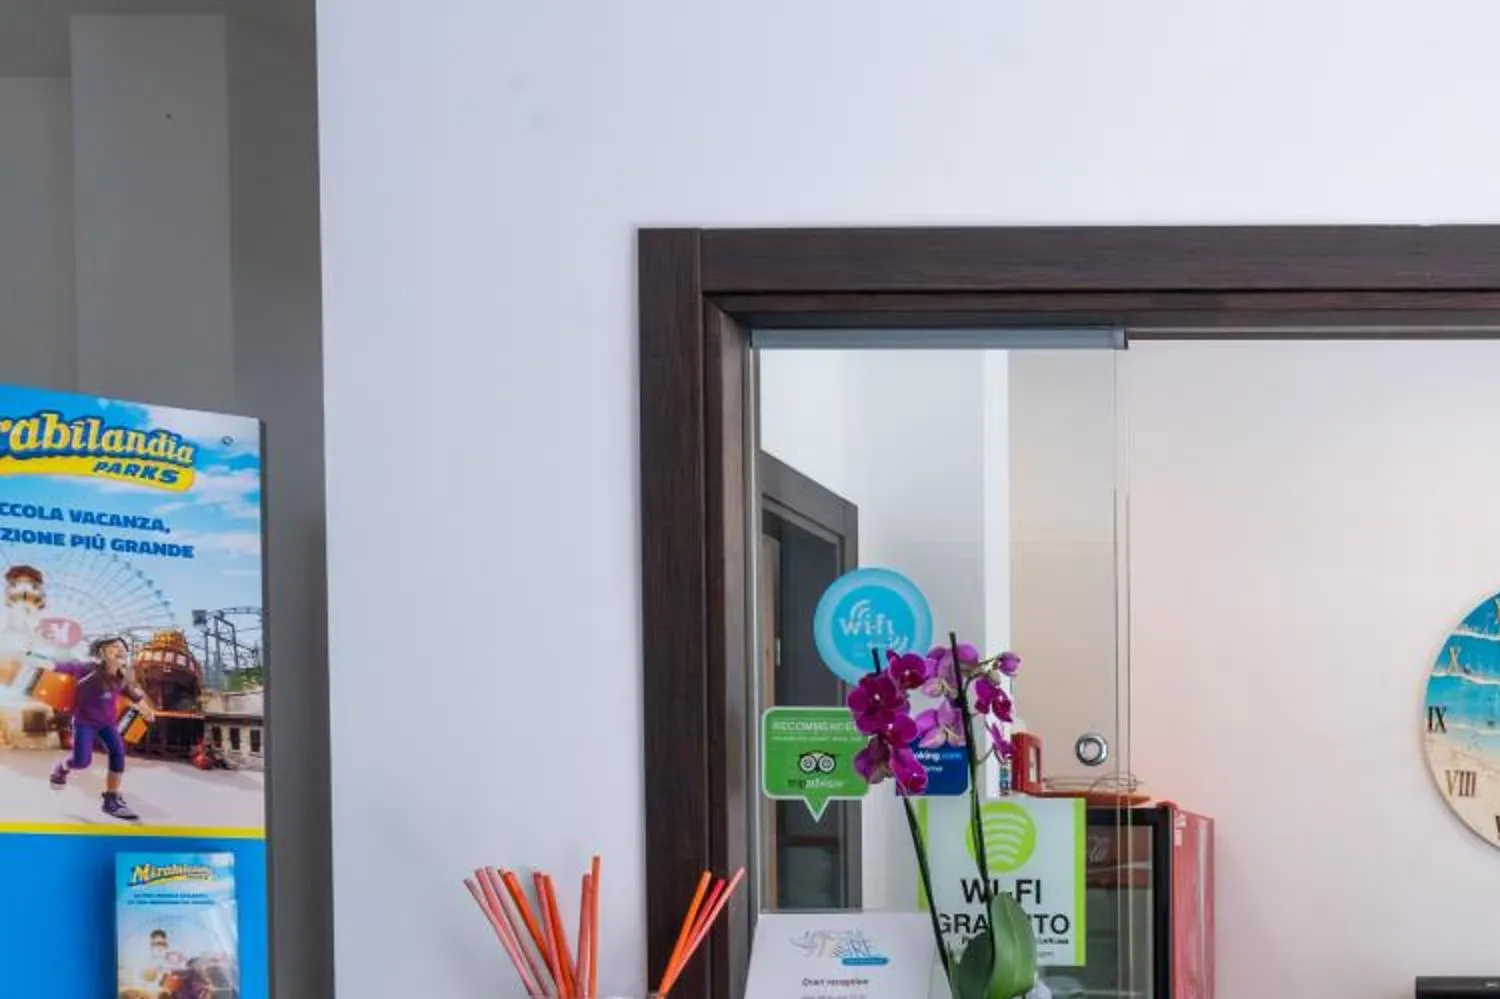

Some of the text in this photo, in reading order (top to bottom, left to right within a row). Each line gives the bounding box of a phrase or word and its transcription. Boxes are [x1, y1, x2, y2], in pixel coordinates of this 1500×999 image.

[92, 461, 180, 484] PARKS
[69, 509, 171, 534] VACANZA,
[110, 537, 195, 559] GRANDE
[772, 720, 858, 732] RECOMMENDE
[1427, 705, 1448, 734] IX
[1445, 769, 1477, 798] VIII
[939, 913, 1071, 935] GRATO
